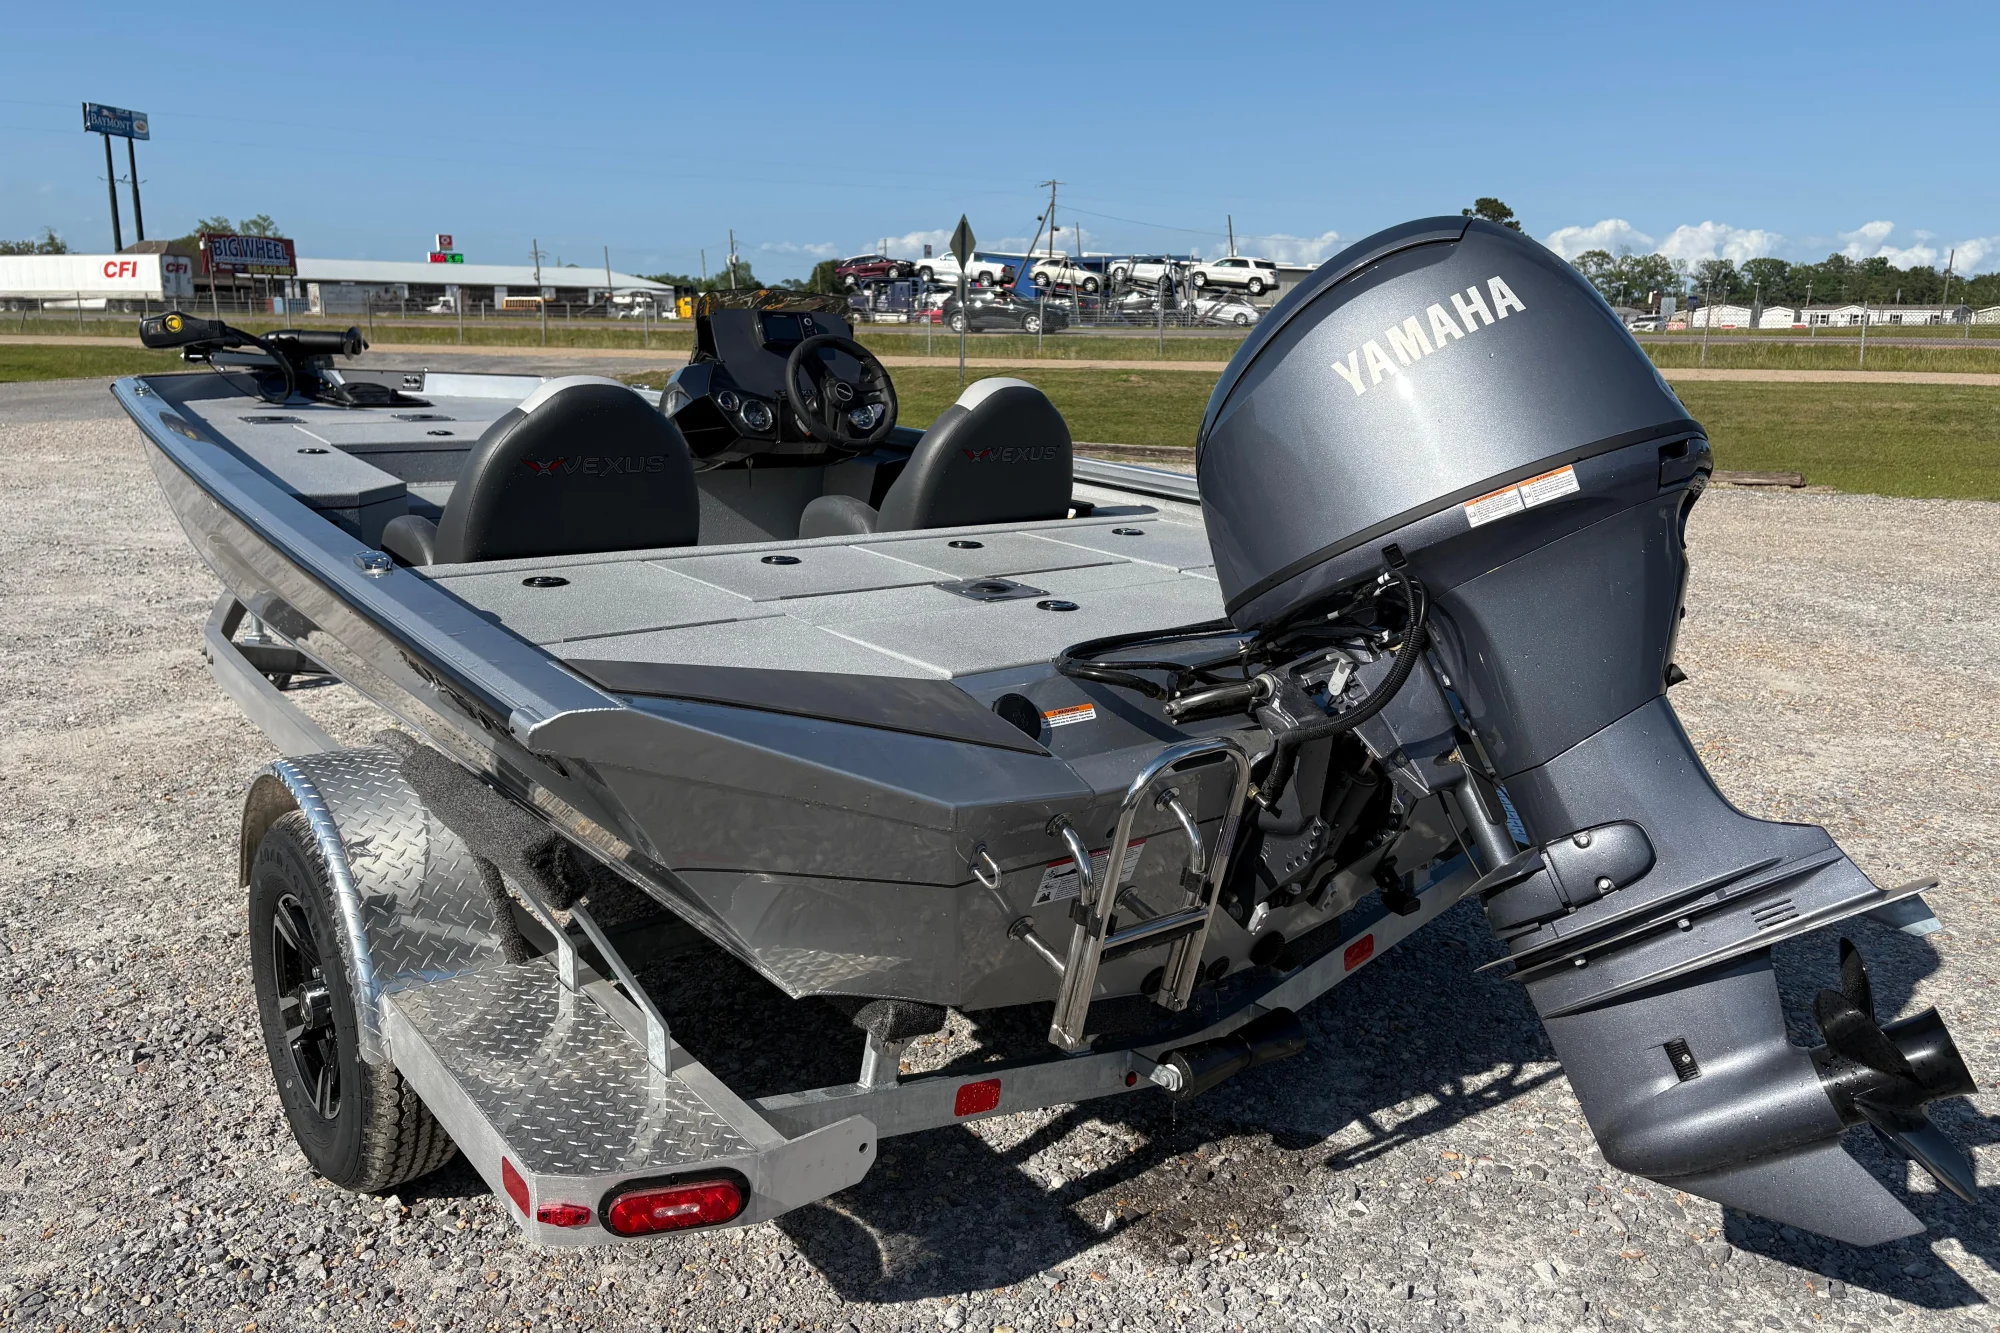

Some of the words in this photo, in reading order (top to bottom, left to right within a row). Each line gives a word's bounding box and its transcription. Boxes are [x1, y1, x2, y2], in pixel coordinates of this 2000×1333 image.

[91, 112, 131, 130] BAYMONT
[213, 237, 239, 257] BIG
[240, 237, 289, 260] WHEEL
[104, 260, 136, 278] CFI
[165, 262, 188, 274] CFI
[1330, 275, 1527, 397] YAMAHA
[988, 446, 1057, 464] VEXUS
[558, 455, 666, 477] VEXUS
[1057, 706, 1080, 715] WARNING
